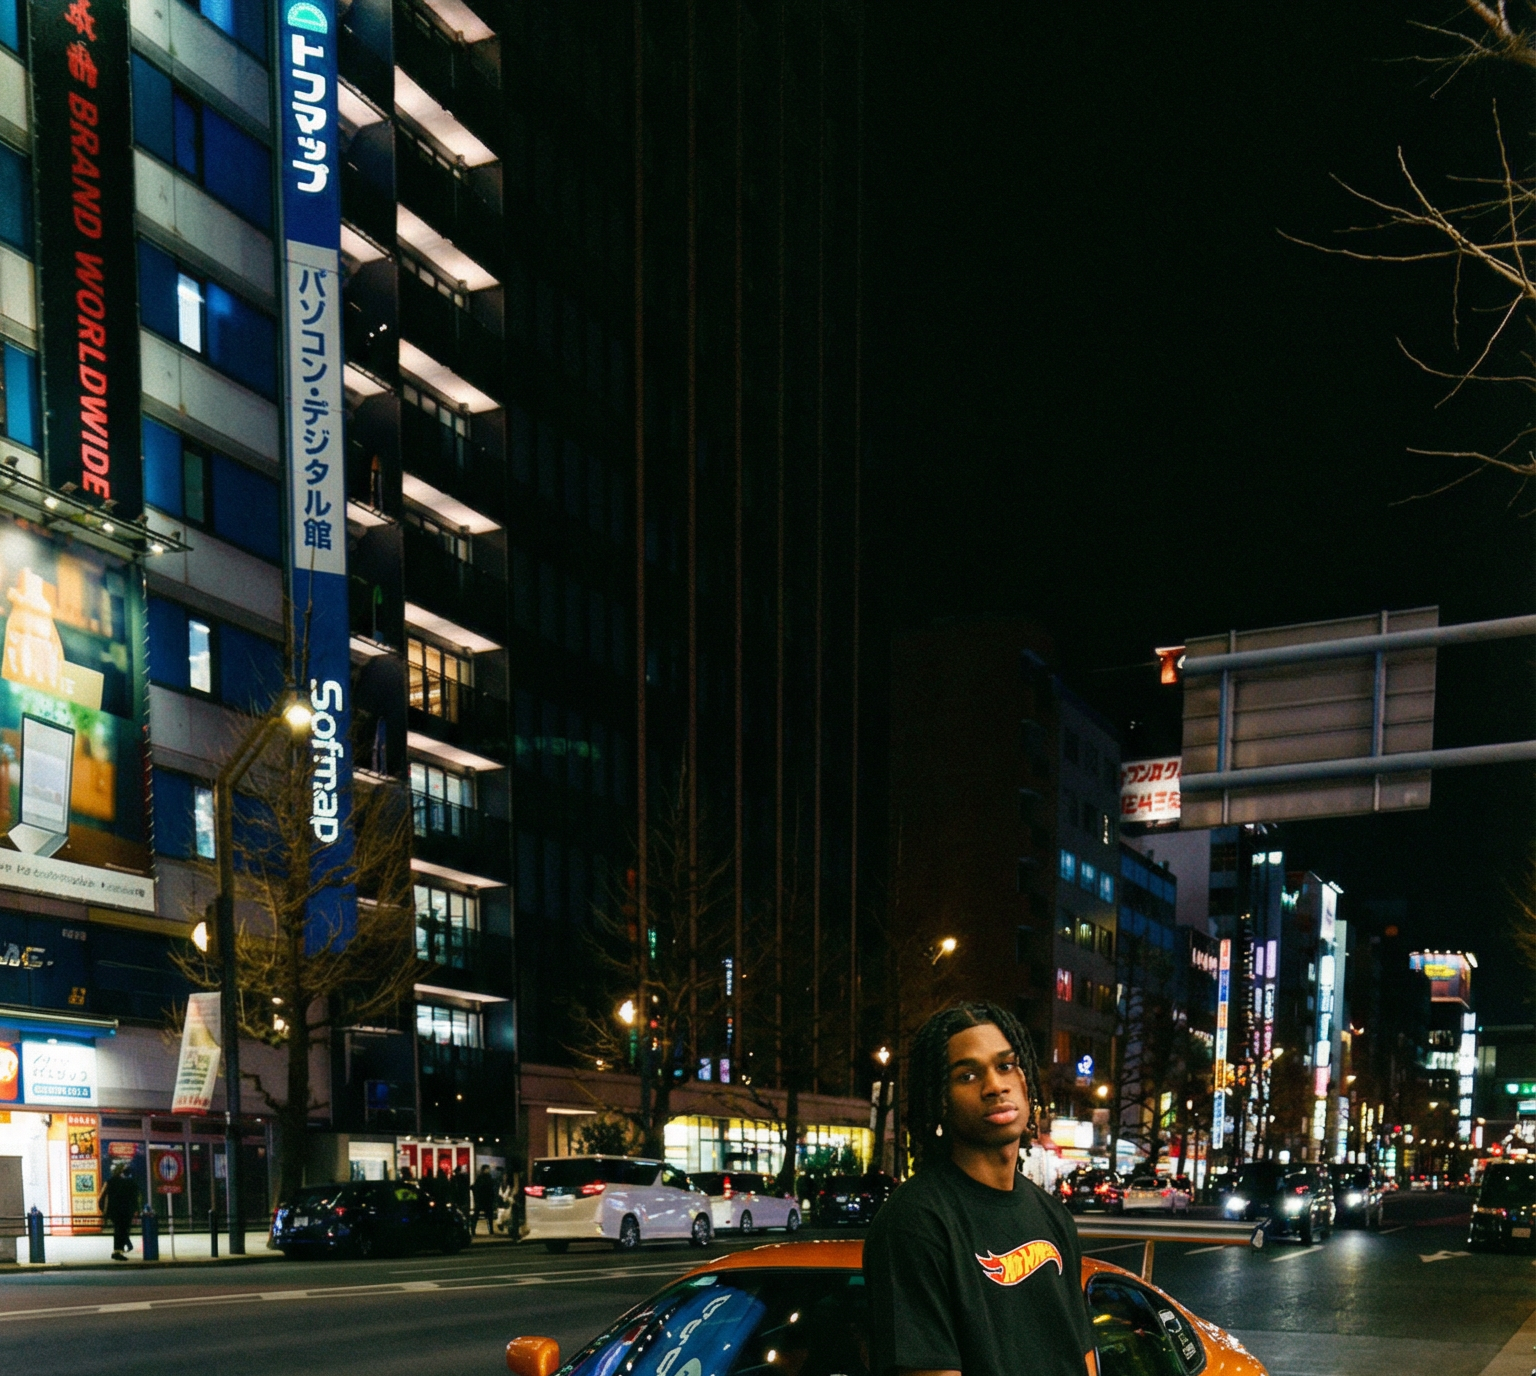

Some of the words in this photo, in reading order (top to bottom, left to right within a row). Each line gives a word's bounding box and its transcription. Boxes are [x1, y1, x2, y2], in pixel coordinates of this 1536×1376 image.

[68, 91, 102, 239] BRAND
[75, 251, 110, 500] WORLDWIDE
[299, 268, 332, 551] パソコン・デジタル館
[309, 678, 344, 843] Sofmap
